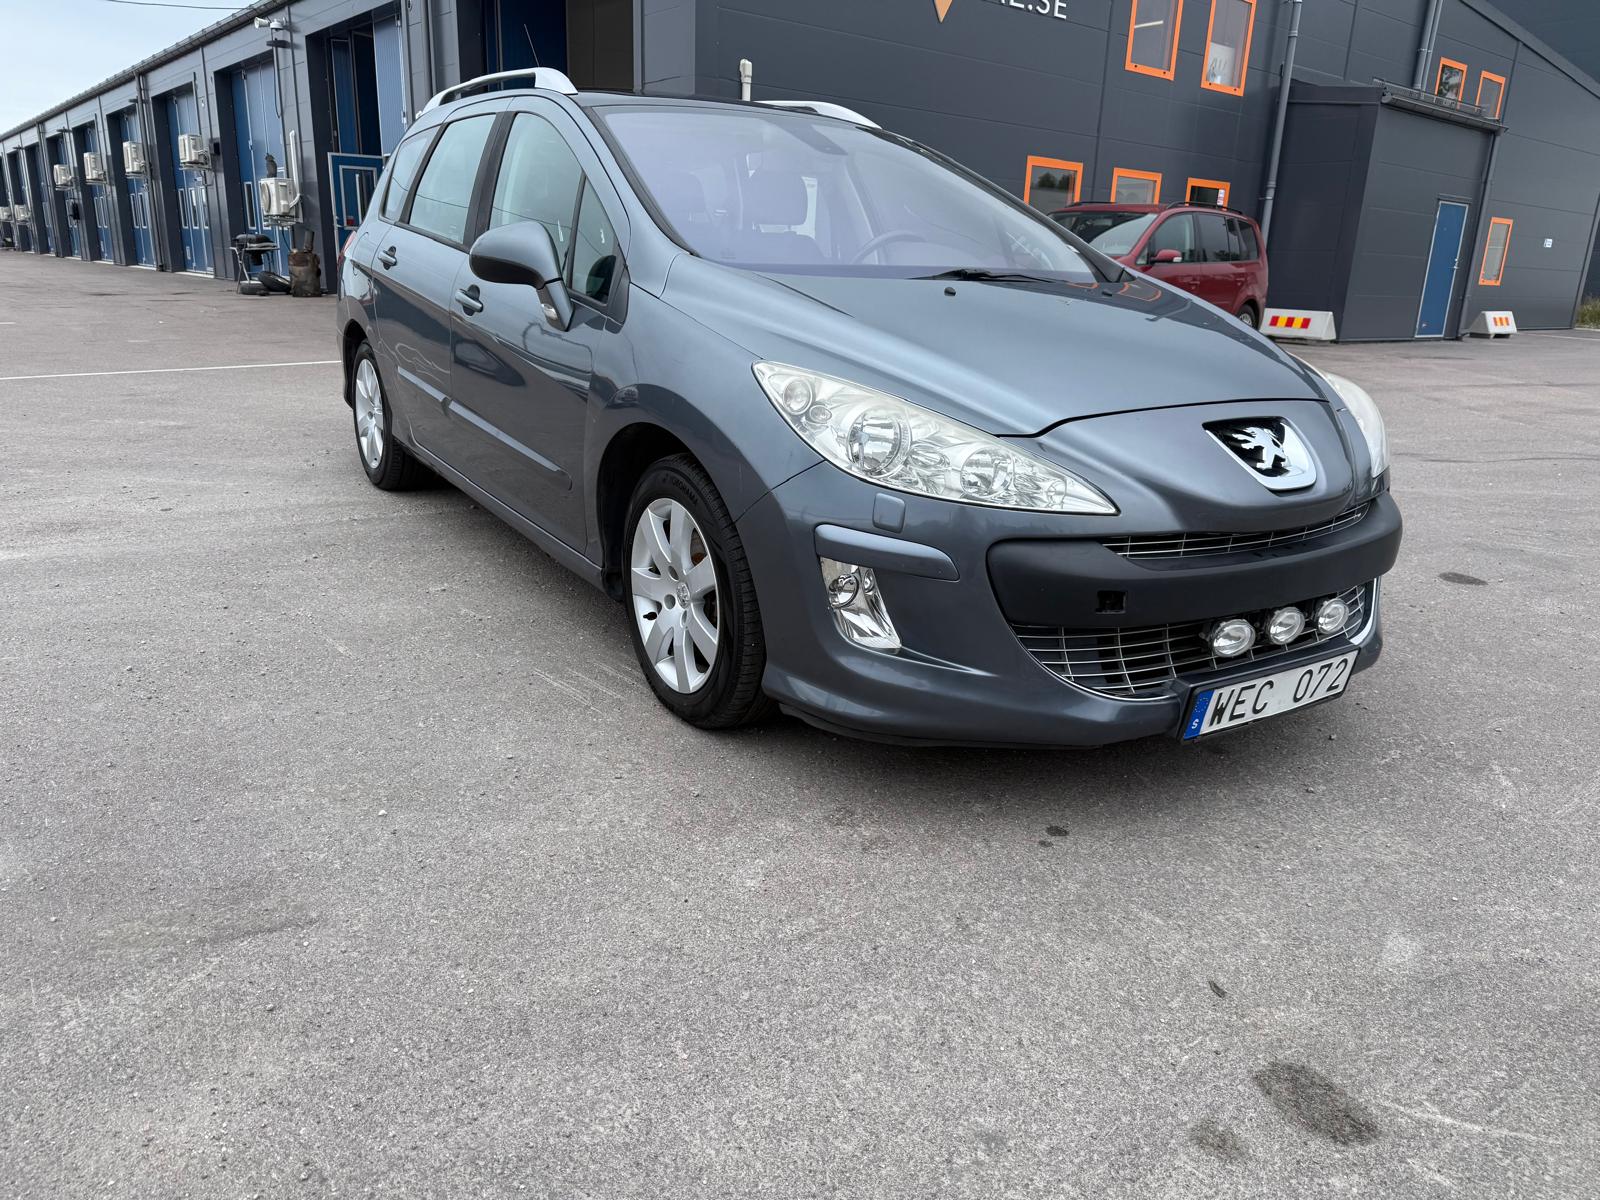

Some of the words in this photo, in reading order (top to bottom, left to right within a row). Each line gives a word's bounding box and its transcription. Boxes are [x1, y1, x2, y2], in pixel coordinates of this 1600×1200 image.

[1208, 680, 1274, 727] WEC
[1293, 658, 1348, 703] 072
[1191, 719, 1199, 729] S
